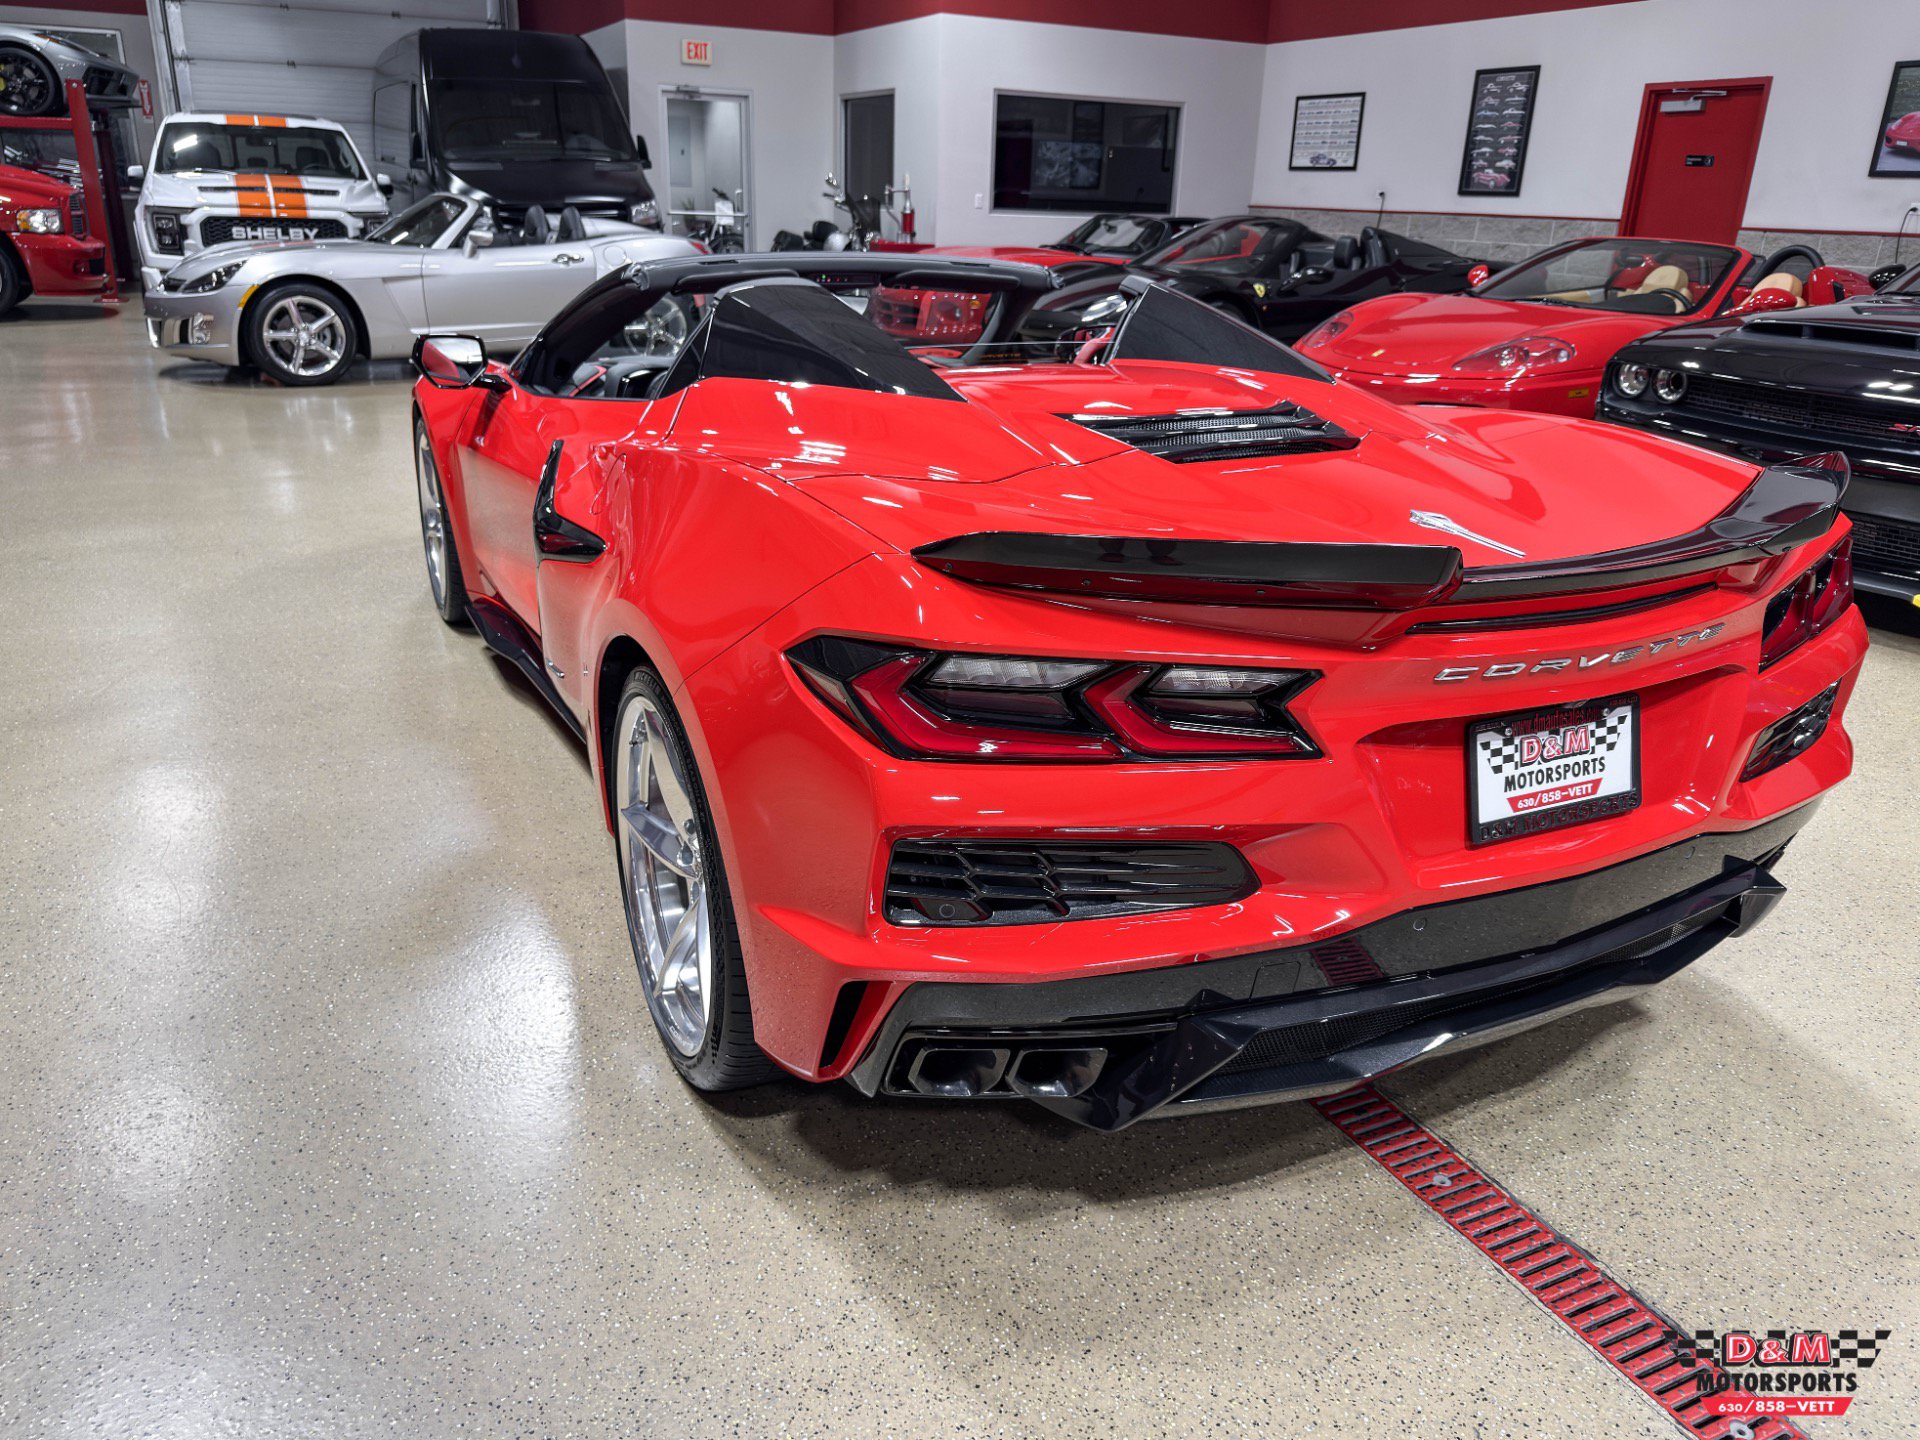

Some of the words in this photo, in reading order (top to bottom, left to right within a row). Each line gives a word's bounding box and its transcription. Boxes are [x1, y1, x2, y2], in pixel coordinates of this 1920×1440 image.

[687, 41, 708, 61] EXIT
[232, 226, 318, 241] SHELBY
[1434, 623, 1726, 682] CORVETTE
[1520, 726, 1590, 765] D&M
[1504, 756, 1606, 793] MOTORSPORTS
[1517, 783, 1594, 809] 630/858-VETT
[1480, 819, 1519, 842] D&M
[1524, 792, 1638, 832] MOTORSPORTS
